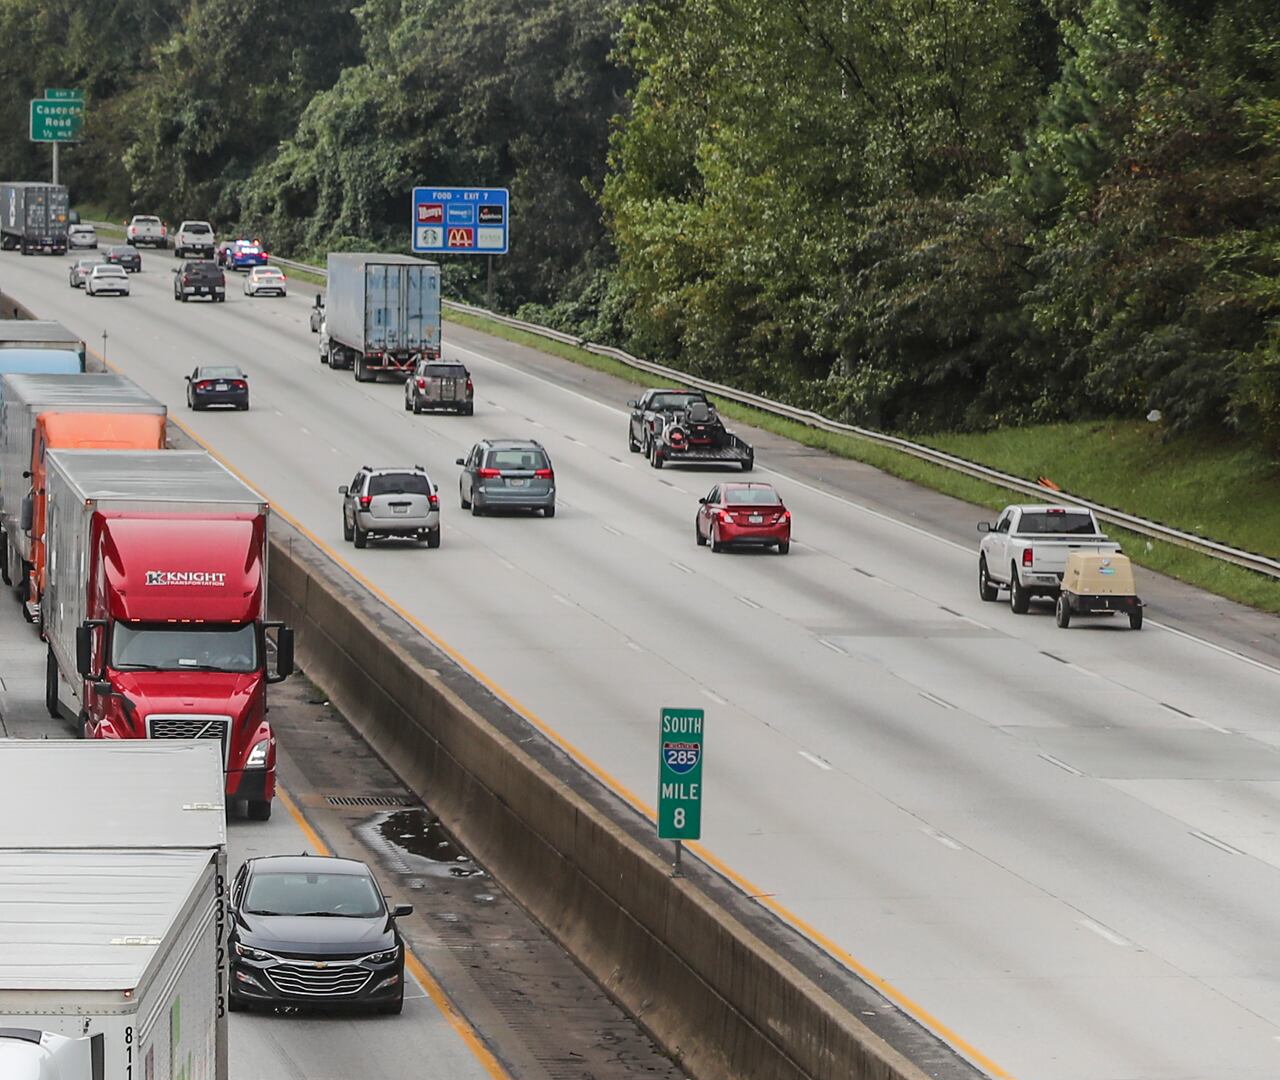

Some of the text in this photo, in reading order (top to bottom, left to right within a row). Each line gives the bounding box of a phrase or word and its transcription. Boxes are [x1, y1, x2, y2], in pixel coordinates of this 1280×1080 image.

[36, 105, 81, 115] Cascade
[45, 117, 71, 126] Road
[432, 192, 452, 200] FOOD
[463, 192, 479, 200] EXIT
[167, 572, 226, 582] KNIGHT
[663, 715, 702, 734] SOUTH
[667, 750, 697, 765] 285
[662, 783, 699, 800] MILE
[673, 807, 685, 829] 8
